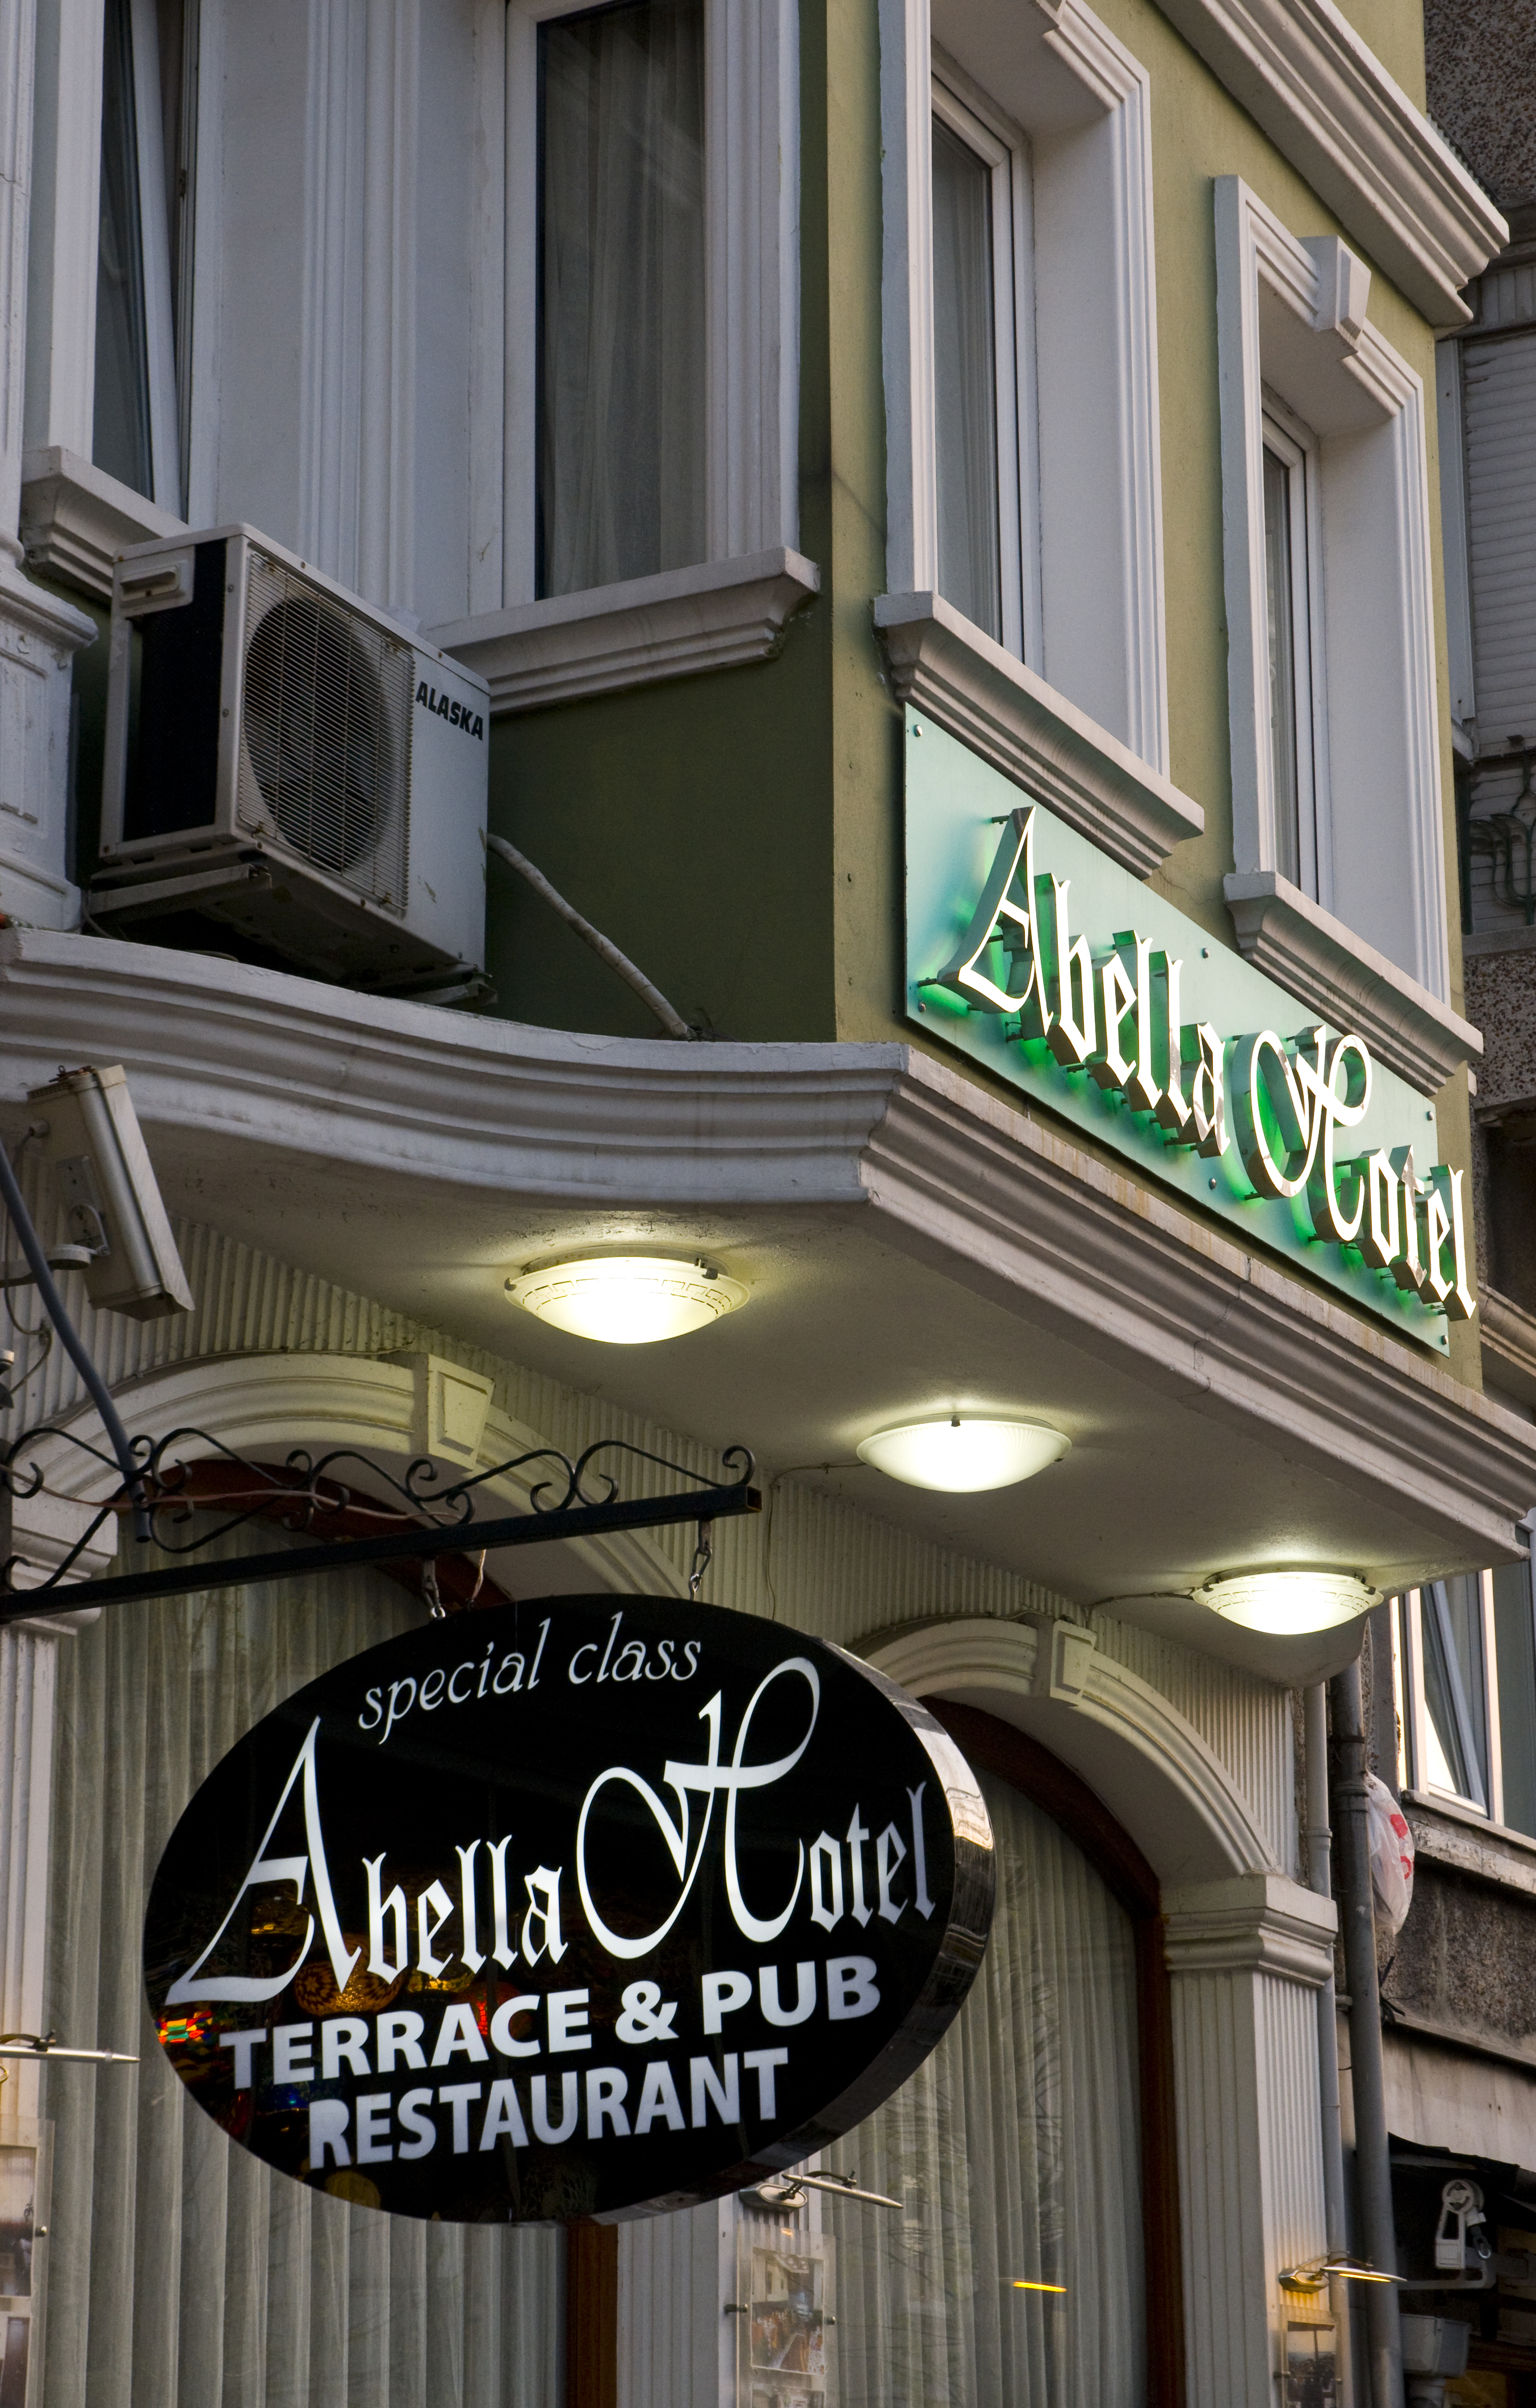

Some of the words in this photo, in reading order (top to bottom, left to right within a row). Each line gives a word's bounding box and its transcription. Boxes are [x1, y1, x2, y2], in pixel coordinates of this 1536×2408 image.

[415, 681, 483, 741] ALASKA
[957, 805, 1231, 1157] Abella
[1250, 1025, 1476, 1319] Hotel
[358, 1617, 551, 1745] special
[568, 1611, 702, 1684] class
[166, 1716, 568, 2006] Abella
[576, 1657, 936, 1959] Hotel
[219, 1988, 592, 2089] TERRACE
[615, 1980, 679, 2044] &
[702, 1955, 881, 2036] PUB
[309, 2047, 789, 2169] RESTAURANT
